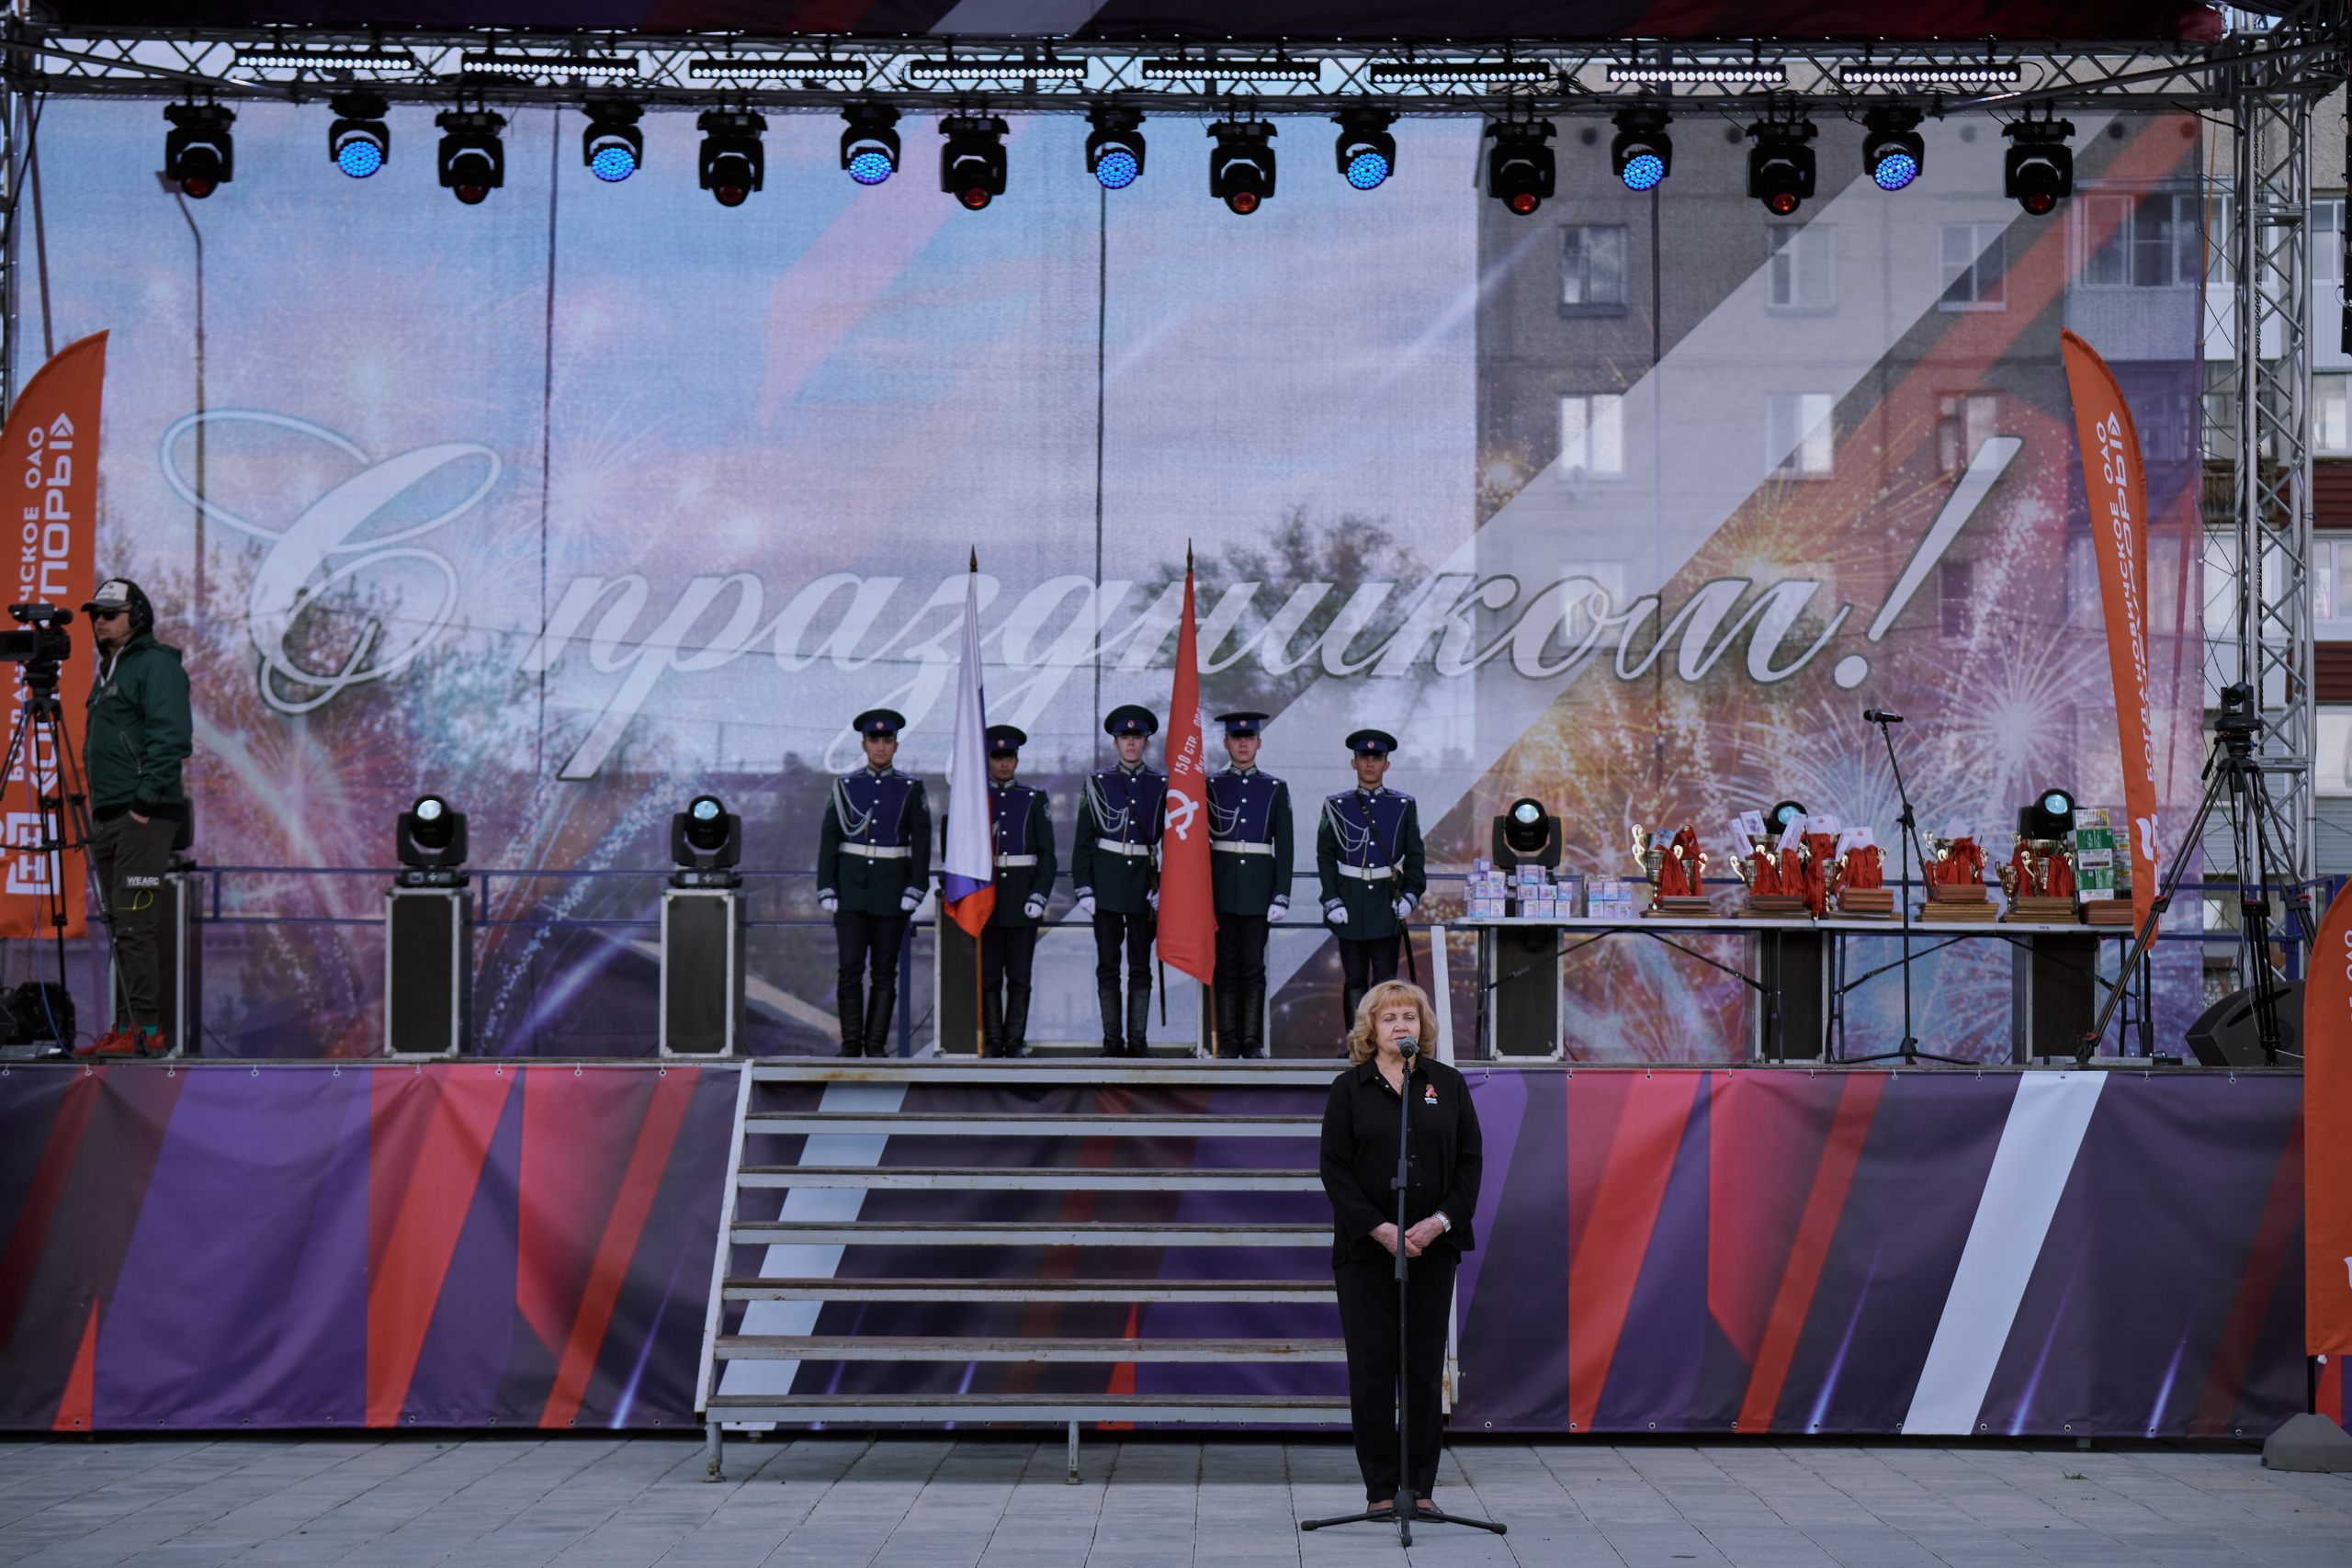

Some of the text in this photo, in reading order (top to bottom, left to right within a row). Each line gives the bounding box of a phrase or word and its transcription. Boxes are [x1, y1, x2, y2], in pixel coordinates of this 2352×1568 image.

[25, 426, 44, 489] ОАО
[159, 408, 2025, 784] С праздником!
[2096, 422, 2154, 782] БОГДАНОВИЧСКОЕ ОАО
[1174, 754, 1192, 775] 150
